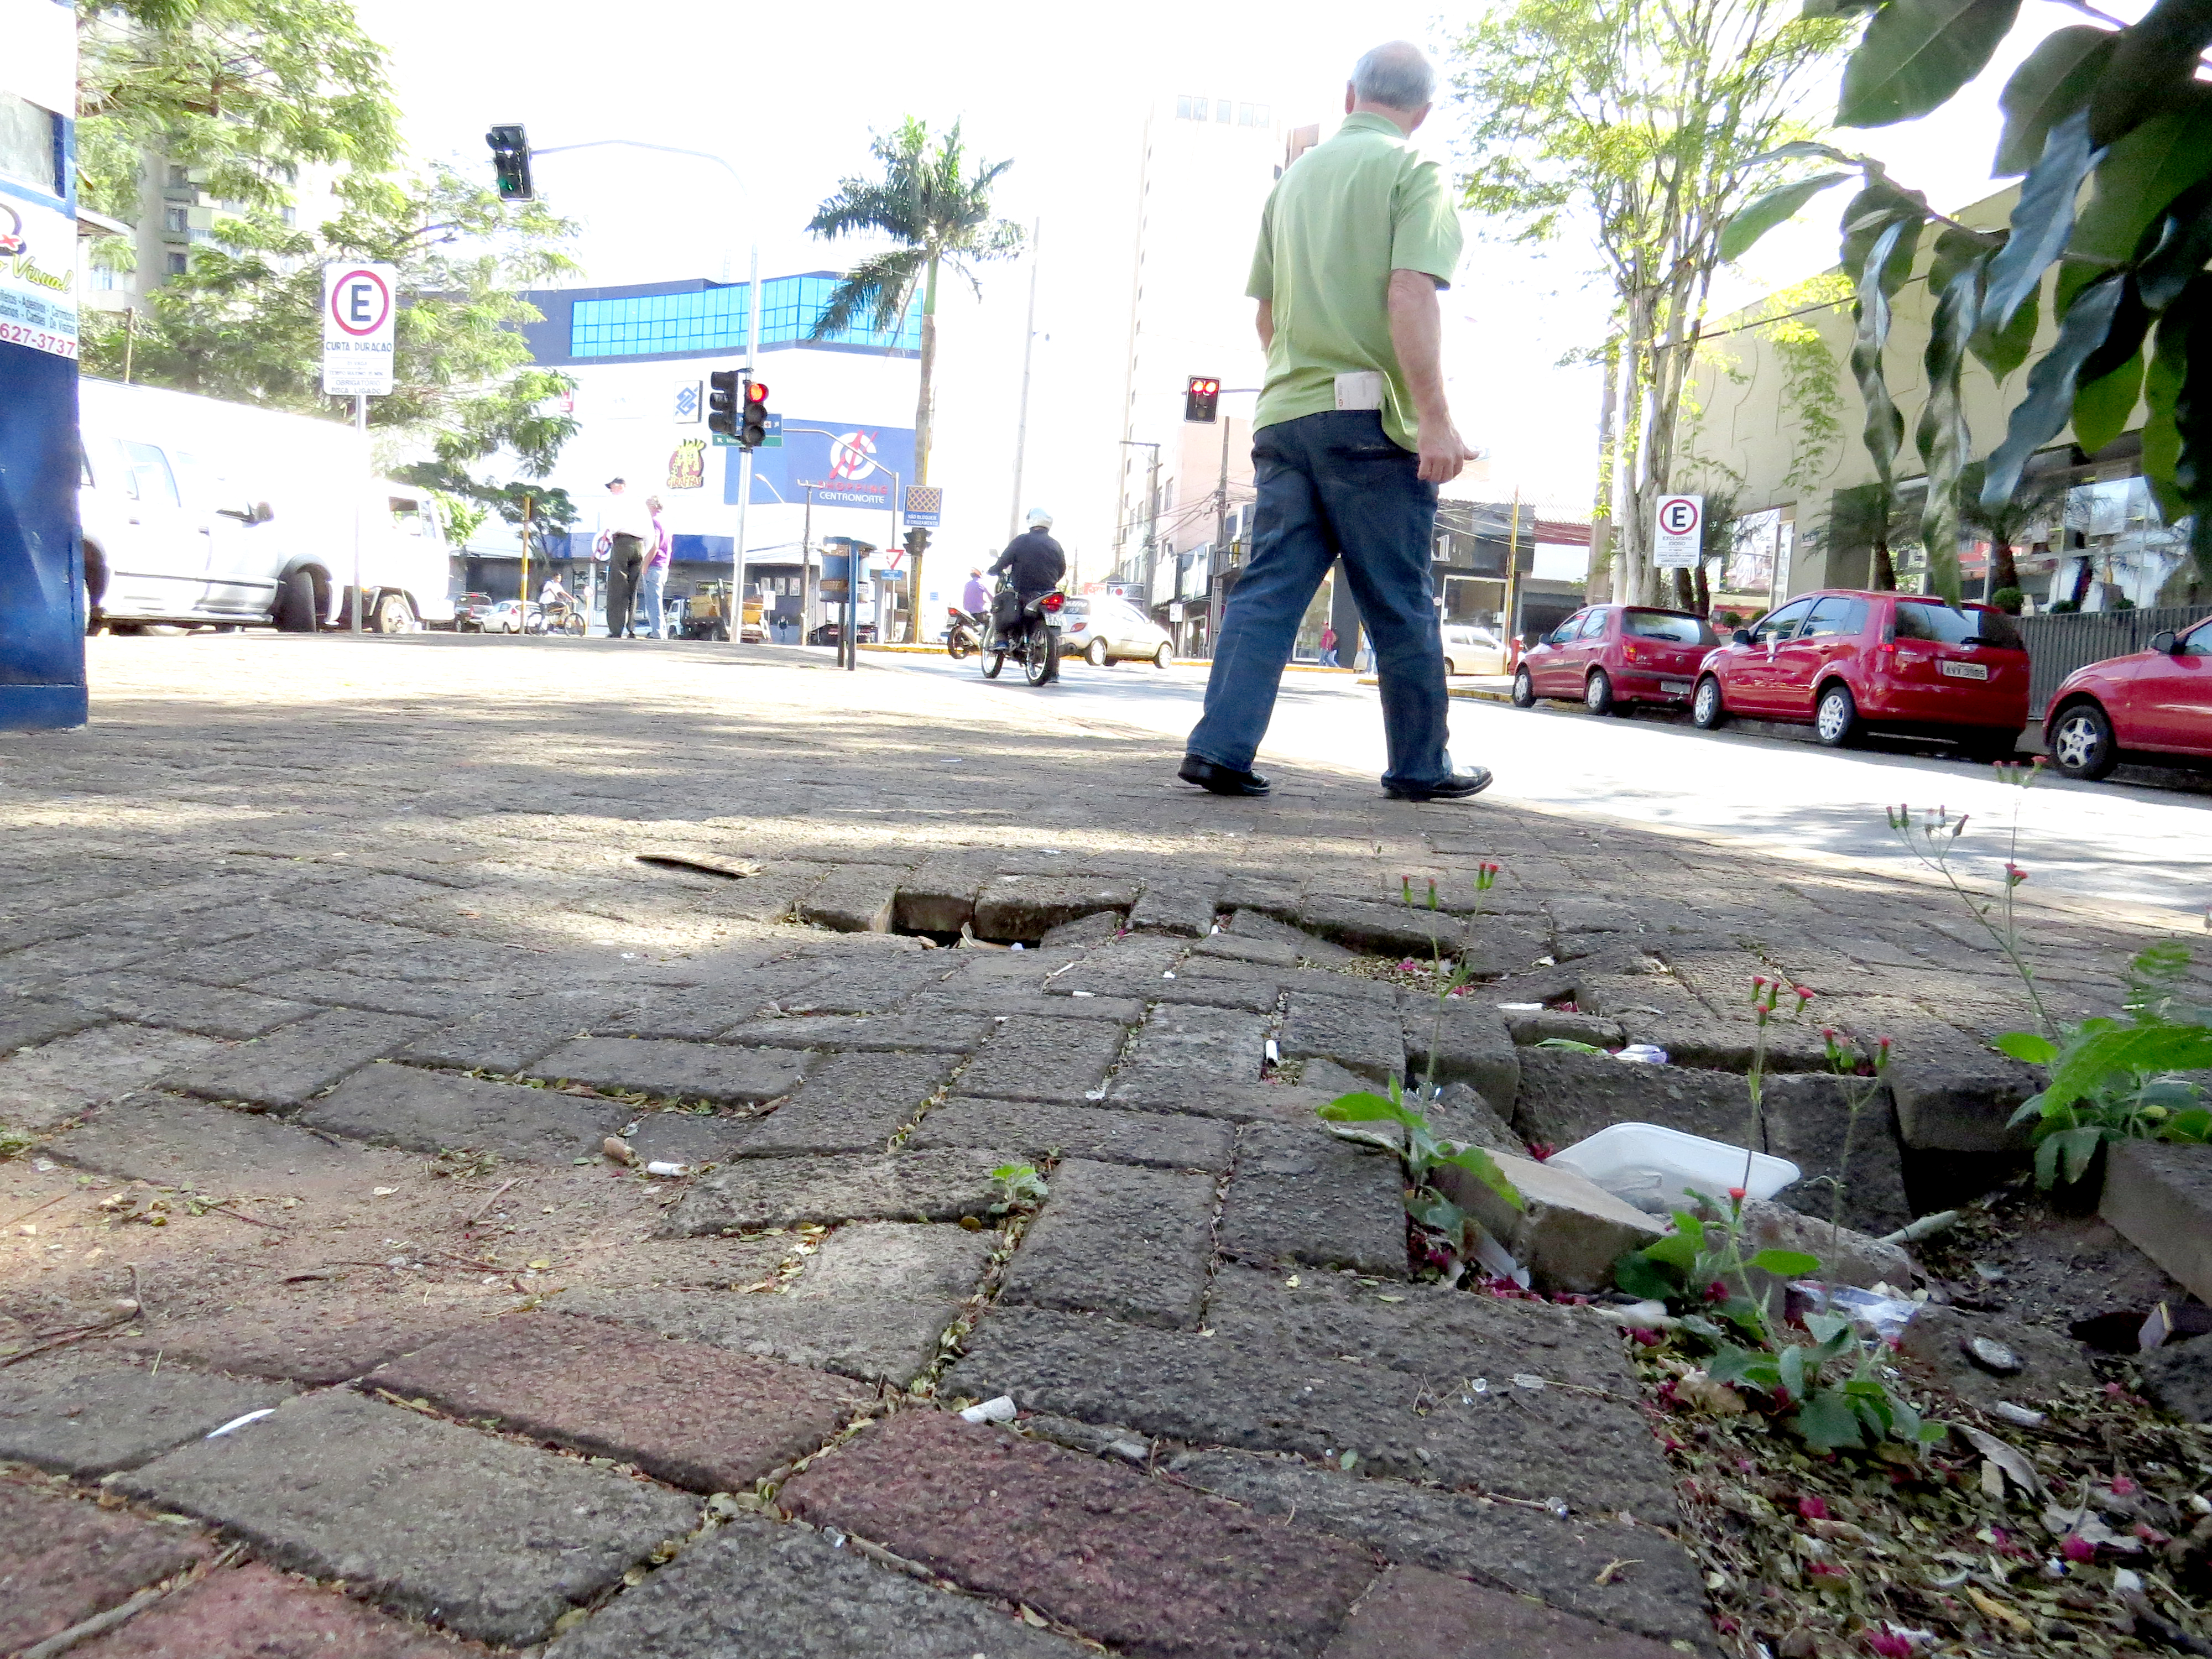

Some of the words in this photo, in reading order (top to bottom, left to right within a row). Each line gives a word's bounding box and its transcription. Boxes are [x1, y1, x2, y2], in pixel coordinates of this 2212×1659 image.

[12, 253, 75, 294] Visual
[351, 285, 372, 321] E
[0, 323, 76, 356] 627-3737
[326, 341, 350, 351] CURTA
[666, 477, 703, 488] GIRAFFAS
[818, 481, 888, 494] SHOPPING
[819, 492, 885, 504] CENTRONORTE
[1672, 507, 1687, 527] E
